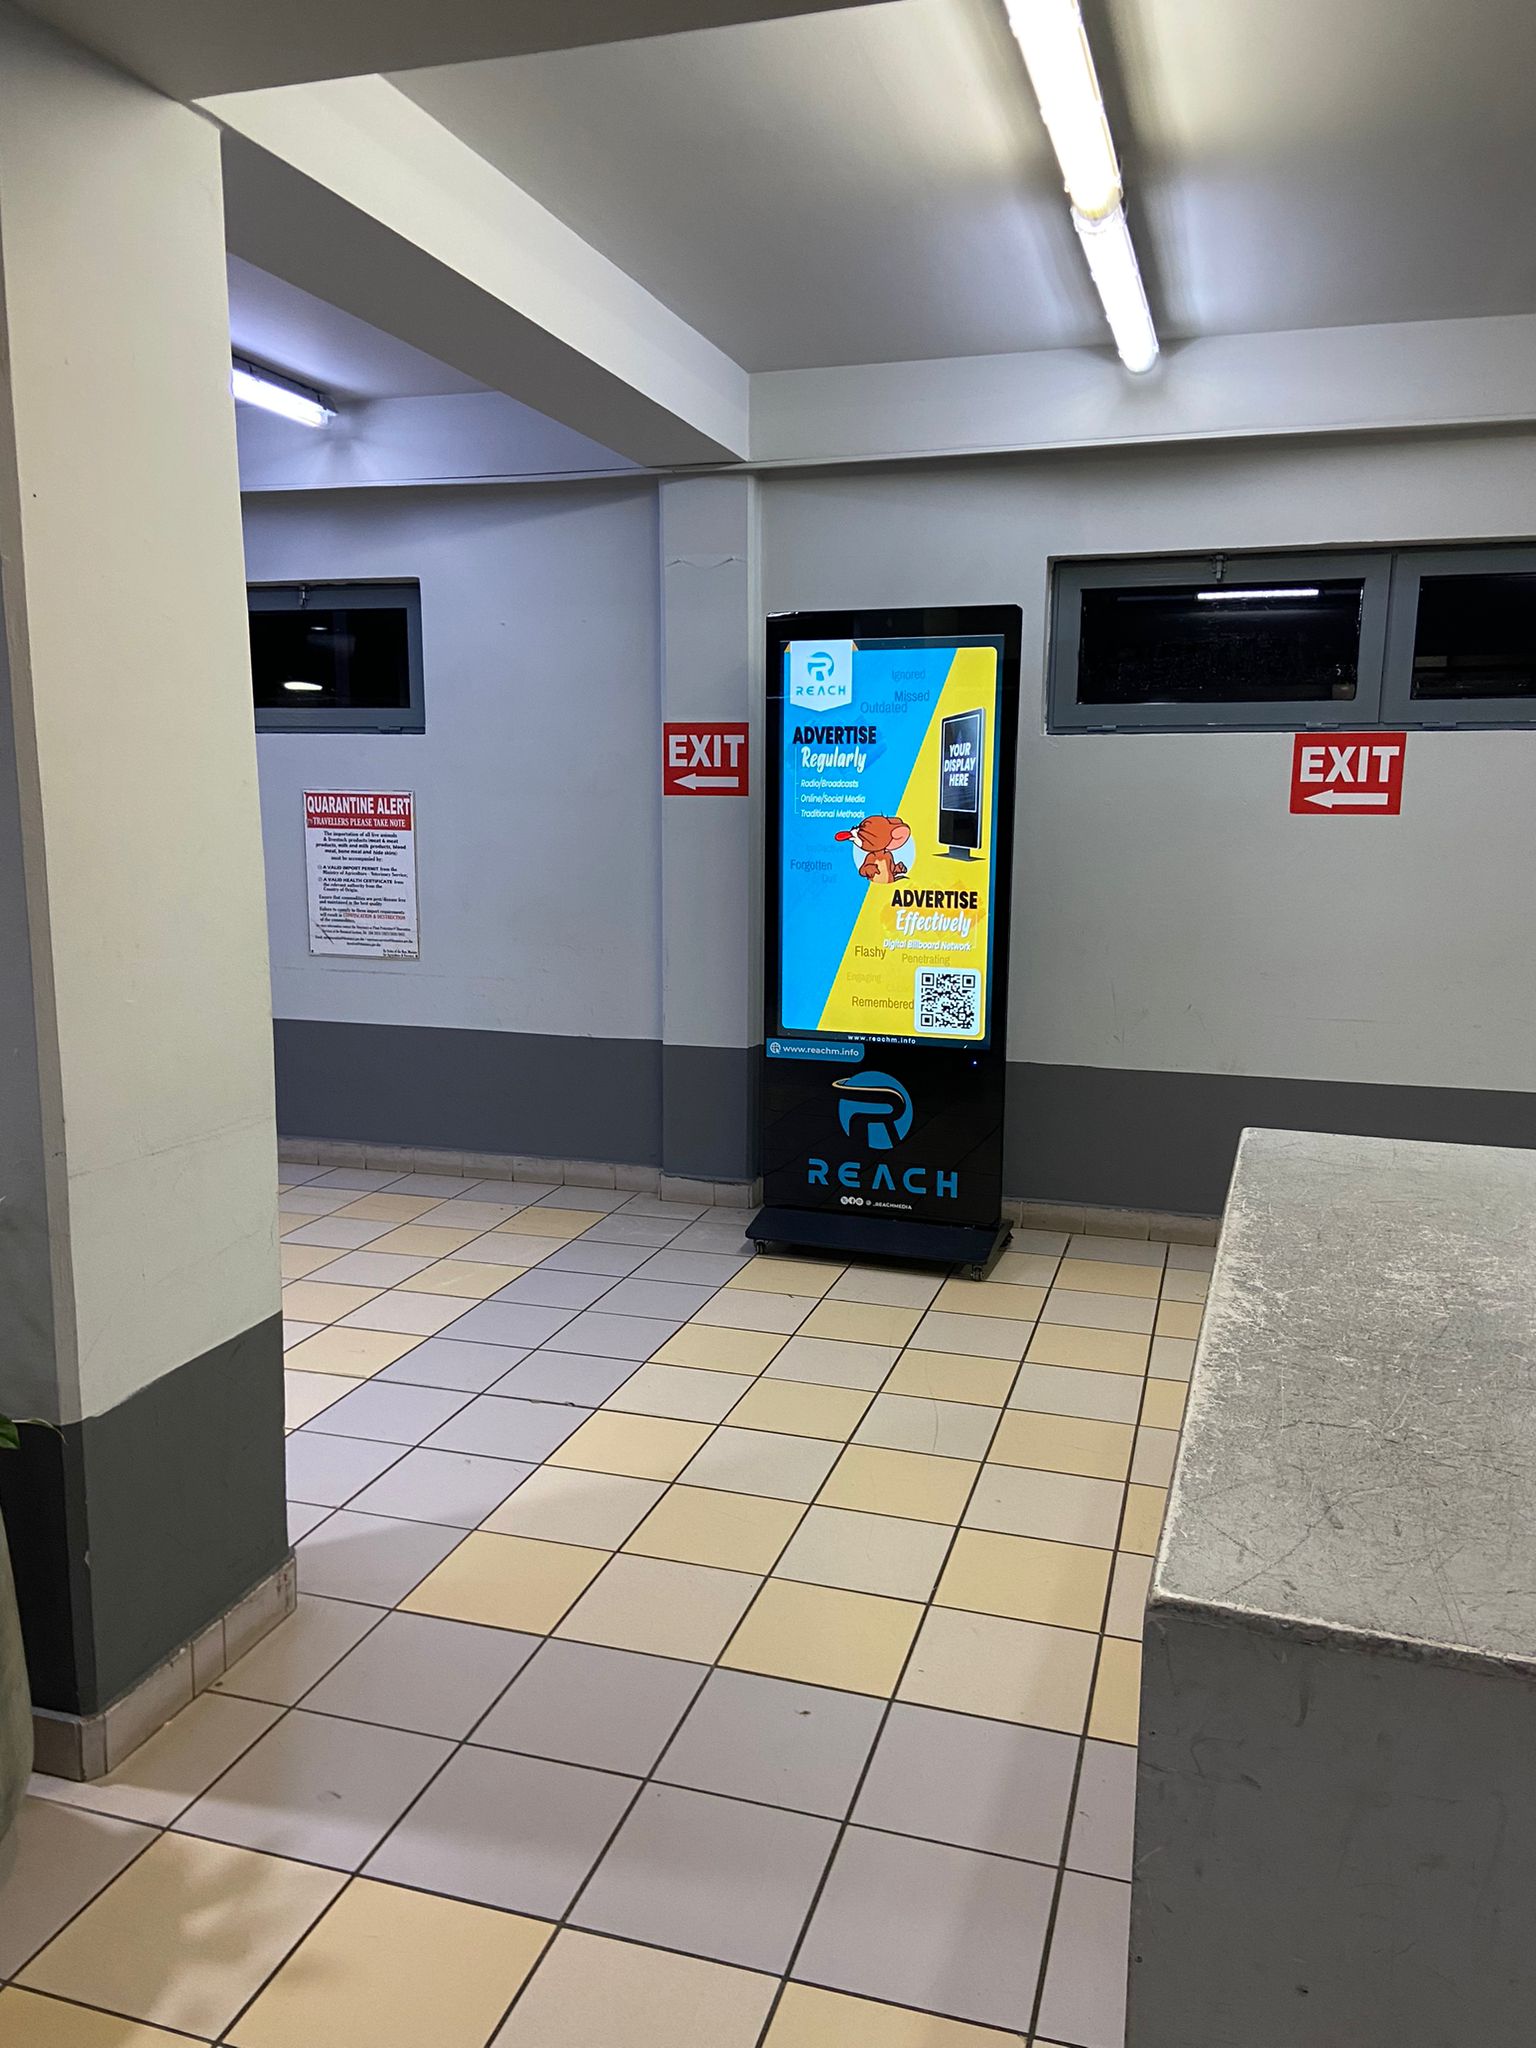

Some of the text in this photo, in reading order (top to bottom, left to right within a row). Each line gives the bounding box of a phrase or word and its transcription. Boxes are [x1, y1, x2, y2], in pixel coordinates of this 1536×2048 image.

[892, 670, 926, 681] Ignored
[796, 686, 846, 696] REACH
[894, 690, 930, 702] Missed
[860, 702, 908, 714] Outdated
[792, 726, 877, 744] ADVERTISE
[668, 734, 745, 767] EXIT
[949, 742, 971, 757] YOUR
[801, 746, 867, 773] Regularly
[944, 757, 976, 772] DISPLAY
[1300, 746, 1400, 782] EXIT
[800, 777, 859, 789] Radio/Broadcasts
[949, 773, 969, 787] HERE
[801, 792, 866, 804] Online/Social Media
[307, 796, 411, 816] QUARANTINE ALERT
[801, 808, 865, 819] Traditional Methods
[312, 817, 405, 828] TRAVELLERS PLEASE TAKE NOTE
[790, 859, 833, 873] Forgotten
[891, 889, 978, 909] ADVERTISE
[895, 909, 972, 937] Effectively
[854, 945, 887, 960] Flashy
[883, 939, 971, 952] Digital Billboard Network
[902, 953, 951, 966] Penetrating
[852, 996, 915, 1010] Remembered
[847, 1035, 916, 1045] www.reachm.info
[782, 1044, 860, 1057] www.reachm.info
[808, 1158, 959, 1198] REACH
